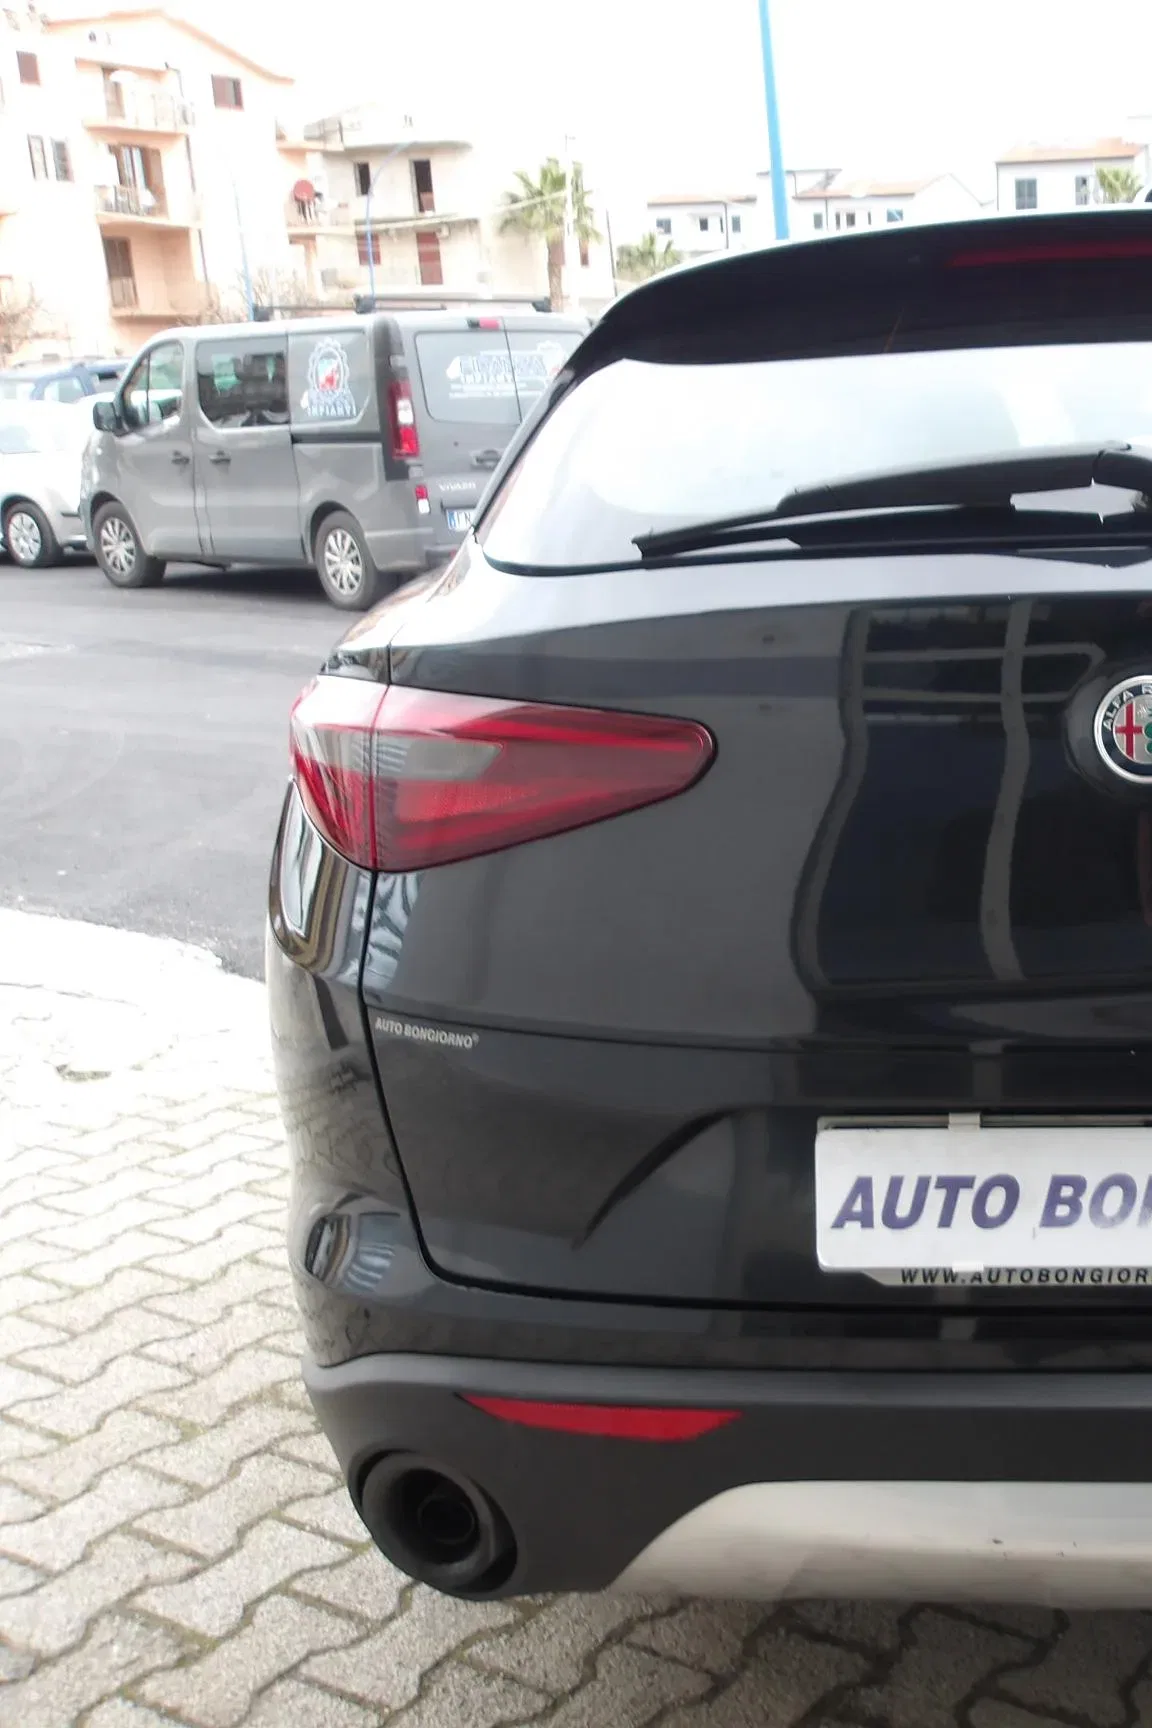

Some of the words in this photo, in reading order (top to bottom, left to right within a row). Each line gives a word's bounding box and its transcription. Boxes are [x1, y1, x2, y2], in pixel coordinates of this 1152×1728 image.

[1103, 689, 1134, 731] ALFA
[375, 1017, 403, 1035] AUTO
[830, 1173, 1020, 1229] AUTO
